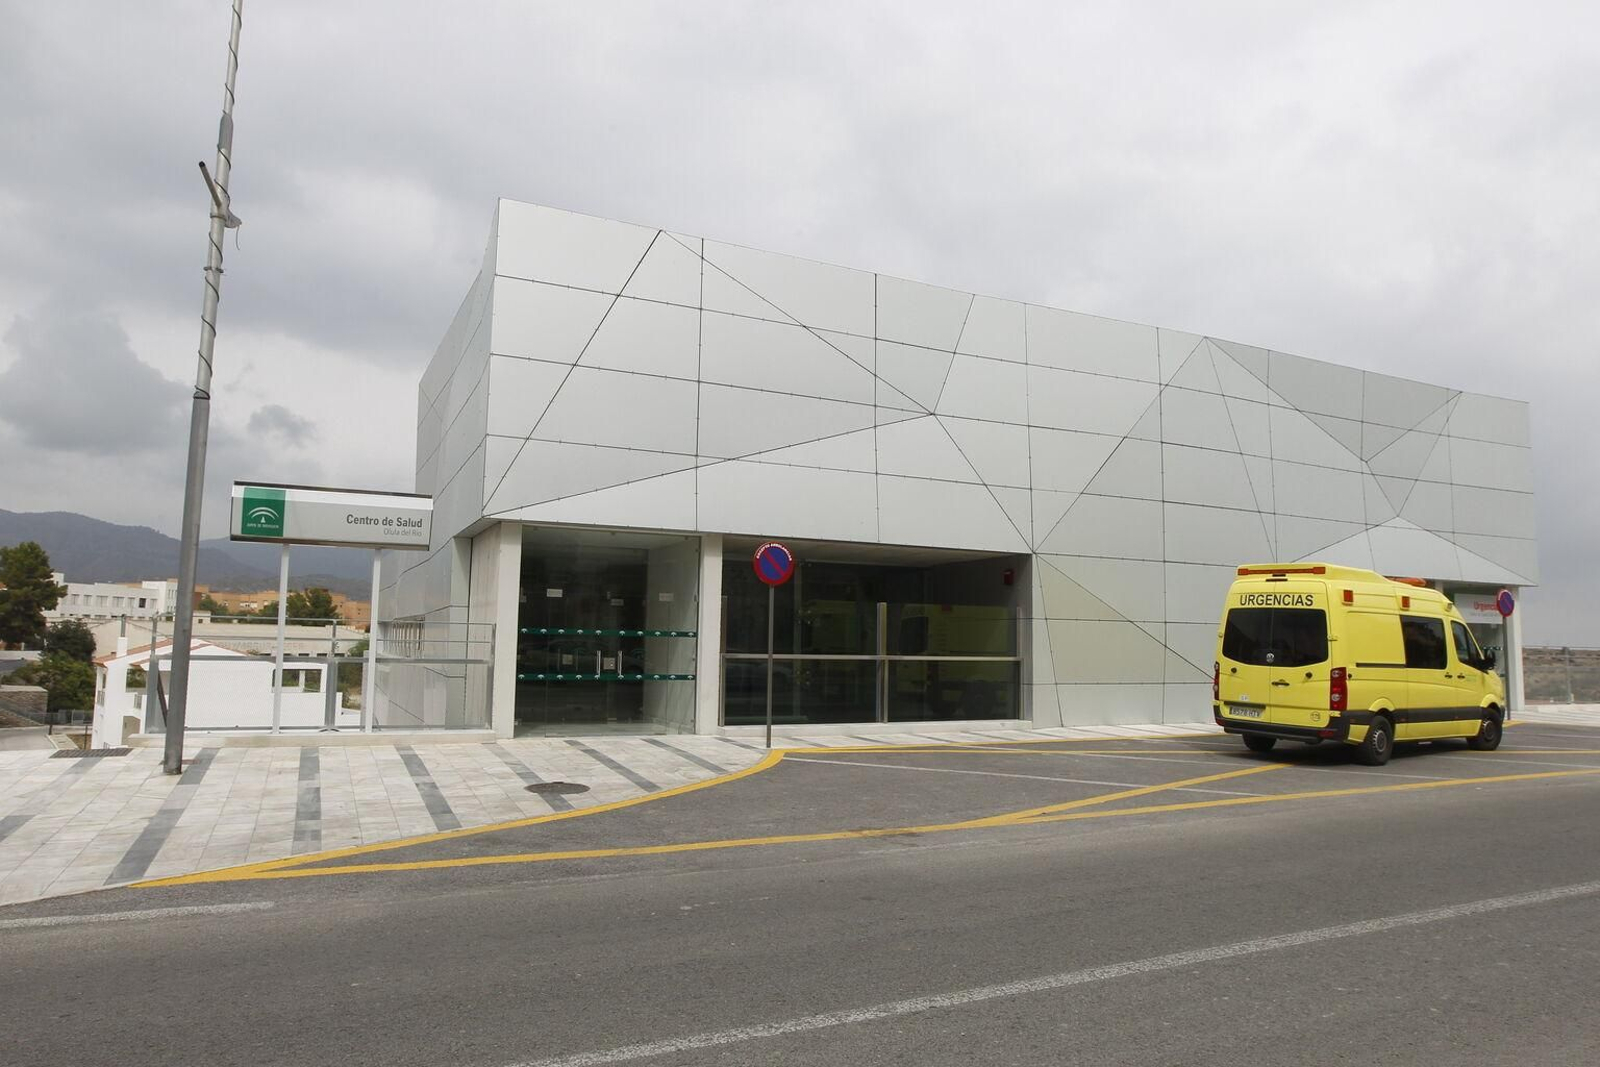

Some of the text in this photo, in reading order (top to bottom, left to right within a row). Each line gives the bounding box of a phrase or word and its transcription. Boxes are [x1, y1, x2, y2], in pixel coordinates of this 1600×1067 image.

[346, 514, 423, 528] Centro de Salud
[1240, 594, 1314, 606] URGENCIAS
